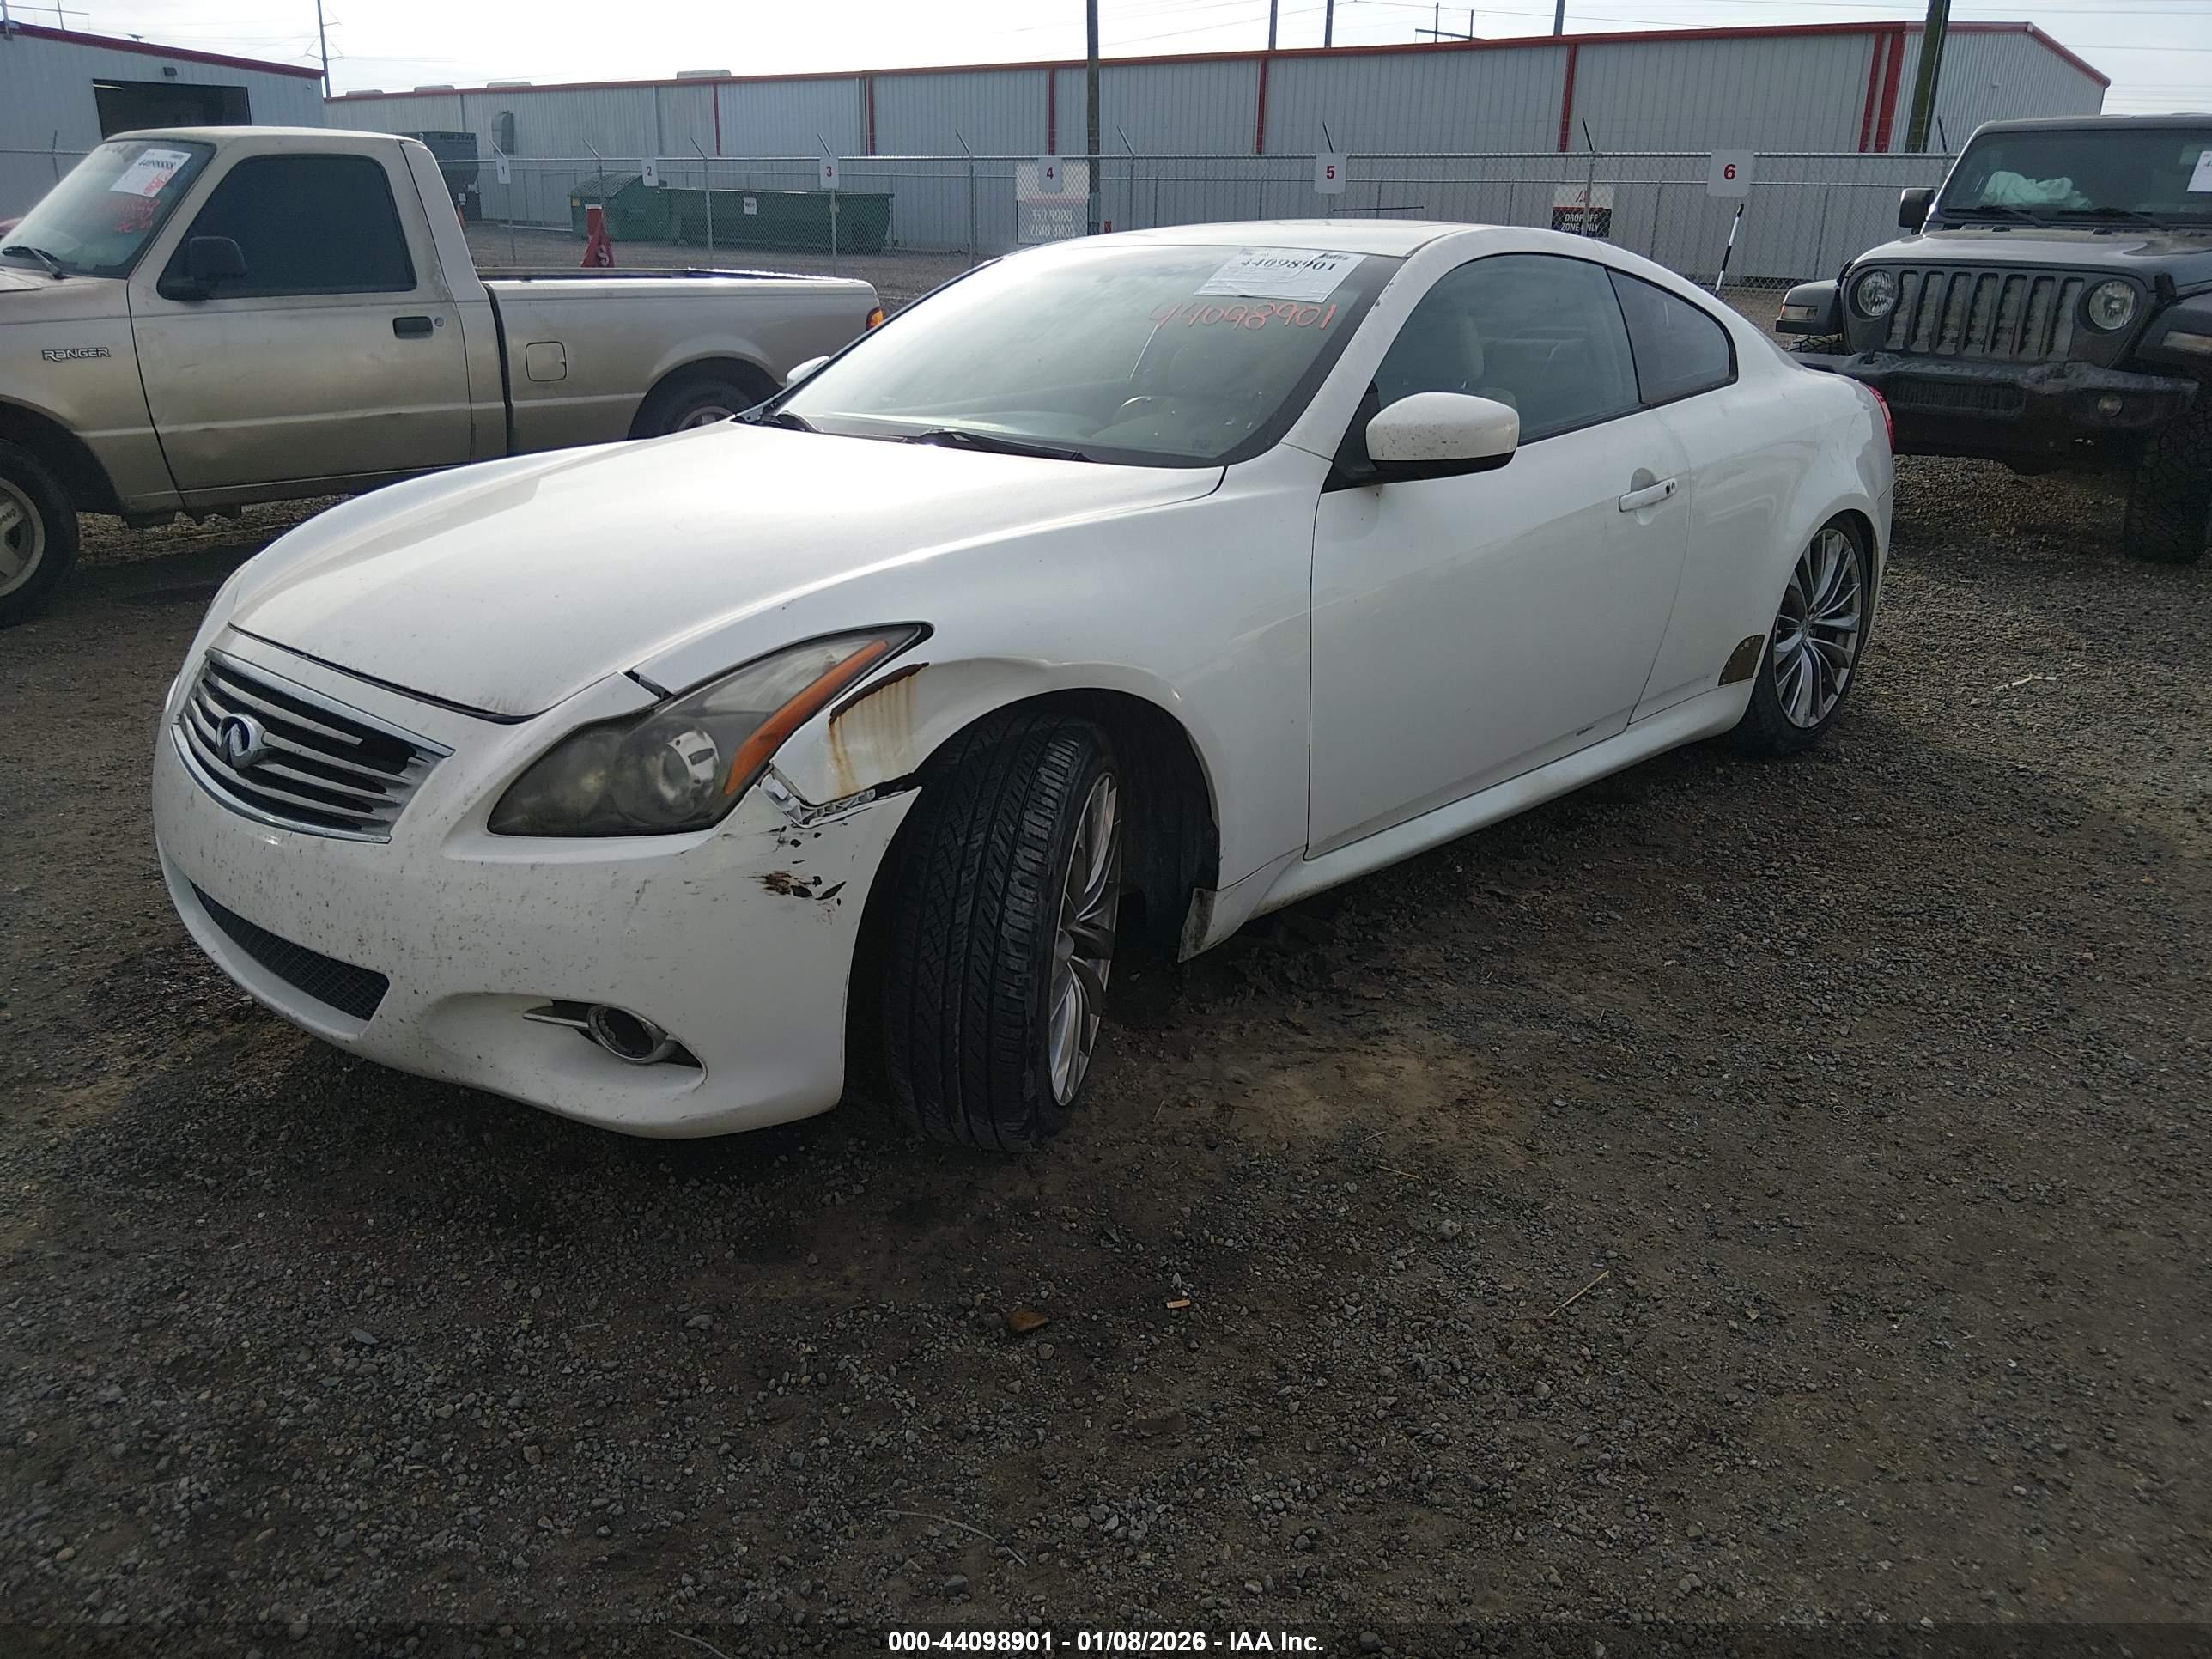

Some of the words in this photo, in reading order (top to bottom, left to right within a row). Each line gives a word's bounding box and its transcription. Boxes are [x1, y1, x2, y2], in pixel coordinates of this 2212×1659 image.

[647, 165, 653, 176] 2
[826, 166, 832, 178] 3
[1046, 167, 1054, 179] 4
[1327, 165, 1335, 179] 5
[1723, 163, 1736, 180] 6
[1565, 213, 1584, 222] DROP
[1560, 222, 1581, 232] ZONE
[1149, 301, 1338, 331] 44098901
[41, 346, 112, 362] RANGER
